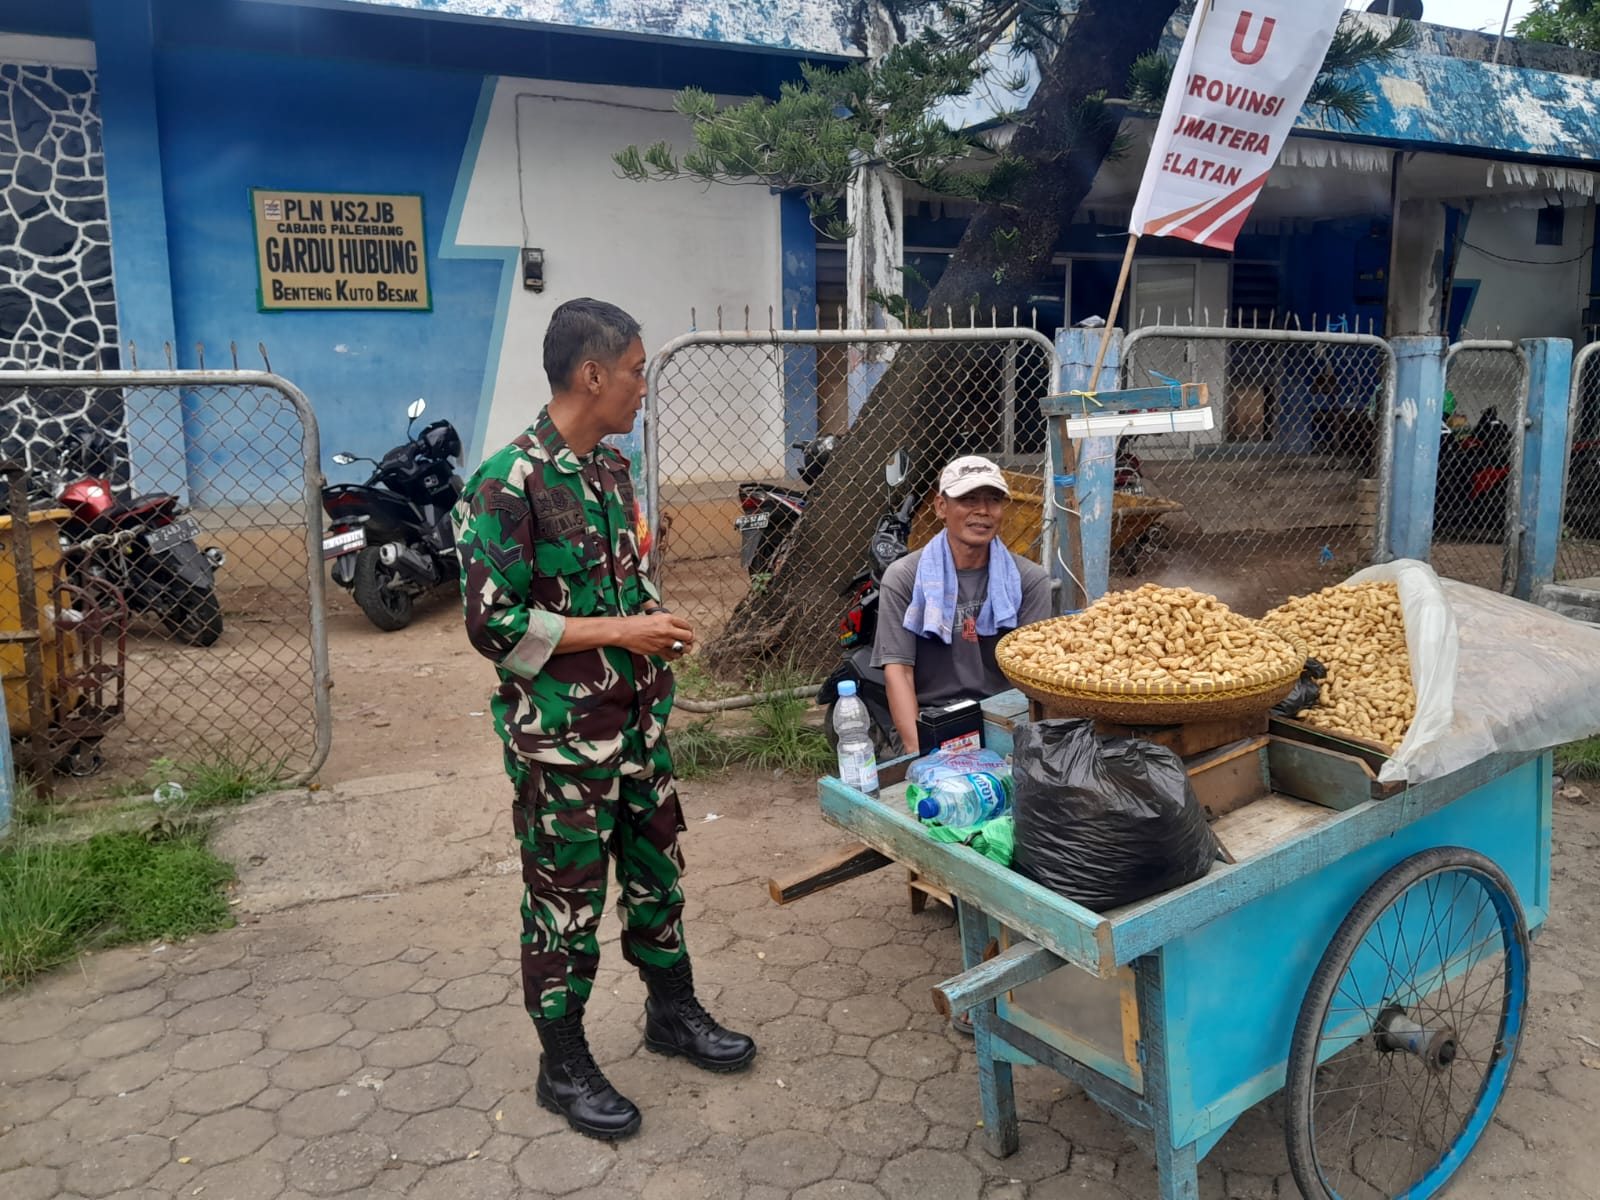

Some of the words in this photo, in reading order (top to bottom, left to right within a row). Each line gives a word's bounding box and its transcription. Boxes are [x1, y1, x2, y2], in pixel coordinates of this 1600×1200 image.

[1187, 74, 1285, 117] ROVINSI
[1174, 115, 1271, 156] UMATERA
[1162, 152, 1243, 187] ELATAN
[277, 223, 326, 235] CABANG
[284, 199, 323, 221] PLN
[331, 201, 394, 224] WS2JB
[266, 237, 335, 274] GARDU
[339, 239, 418, 274] HUBUNG
[973, 774, 994, 806] AQUA
